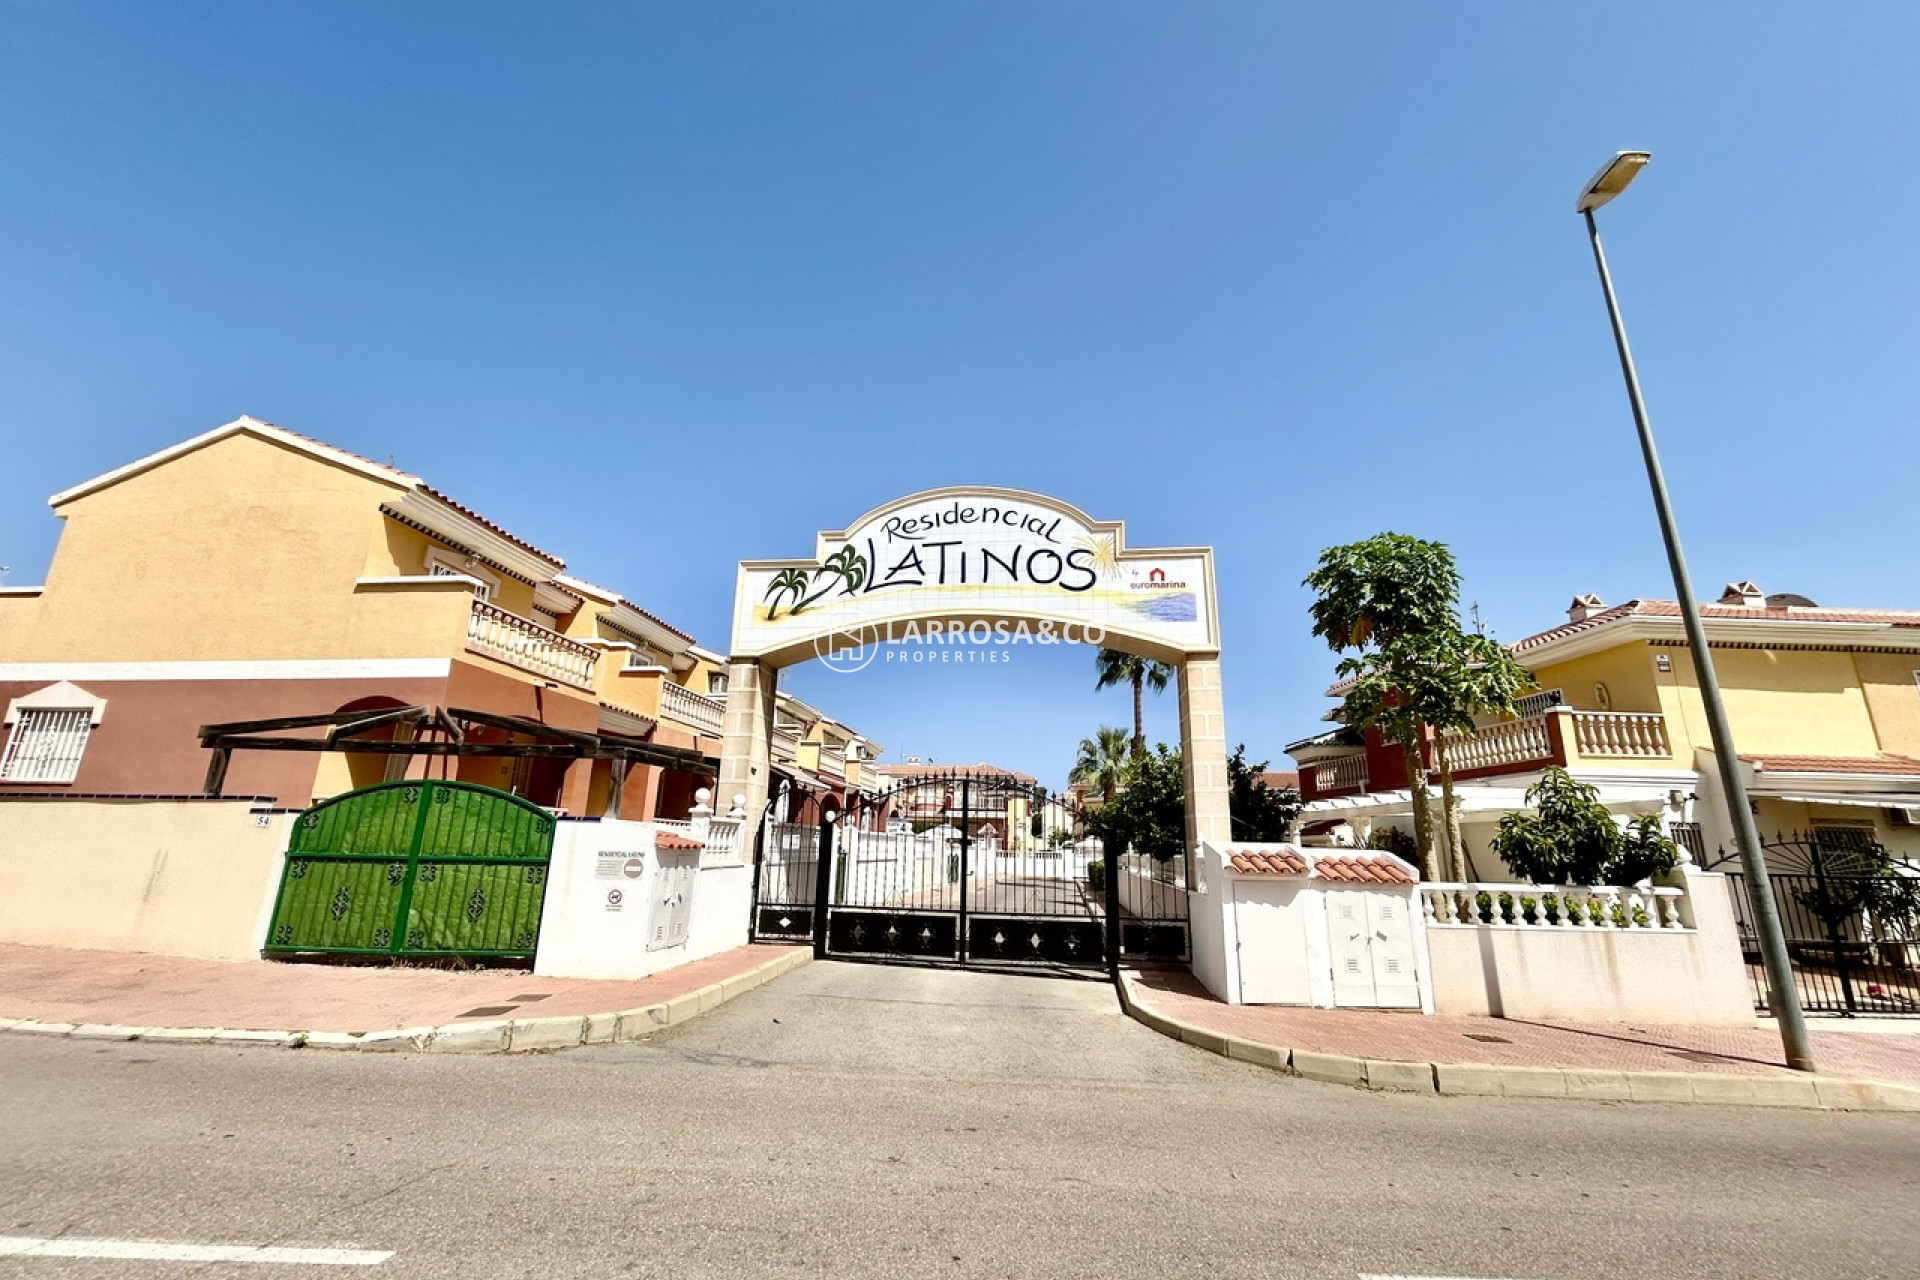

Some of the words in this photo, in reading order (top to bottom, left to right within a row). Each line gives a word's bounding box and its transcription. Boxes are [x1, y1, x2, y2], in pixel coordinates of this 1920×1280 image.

[880, 501, 1062, 544] Residencial
[863, 537, 1097, 593] LATINOS
[1130, 581, 1186, 589] euromarina
